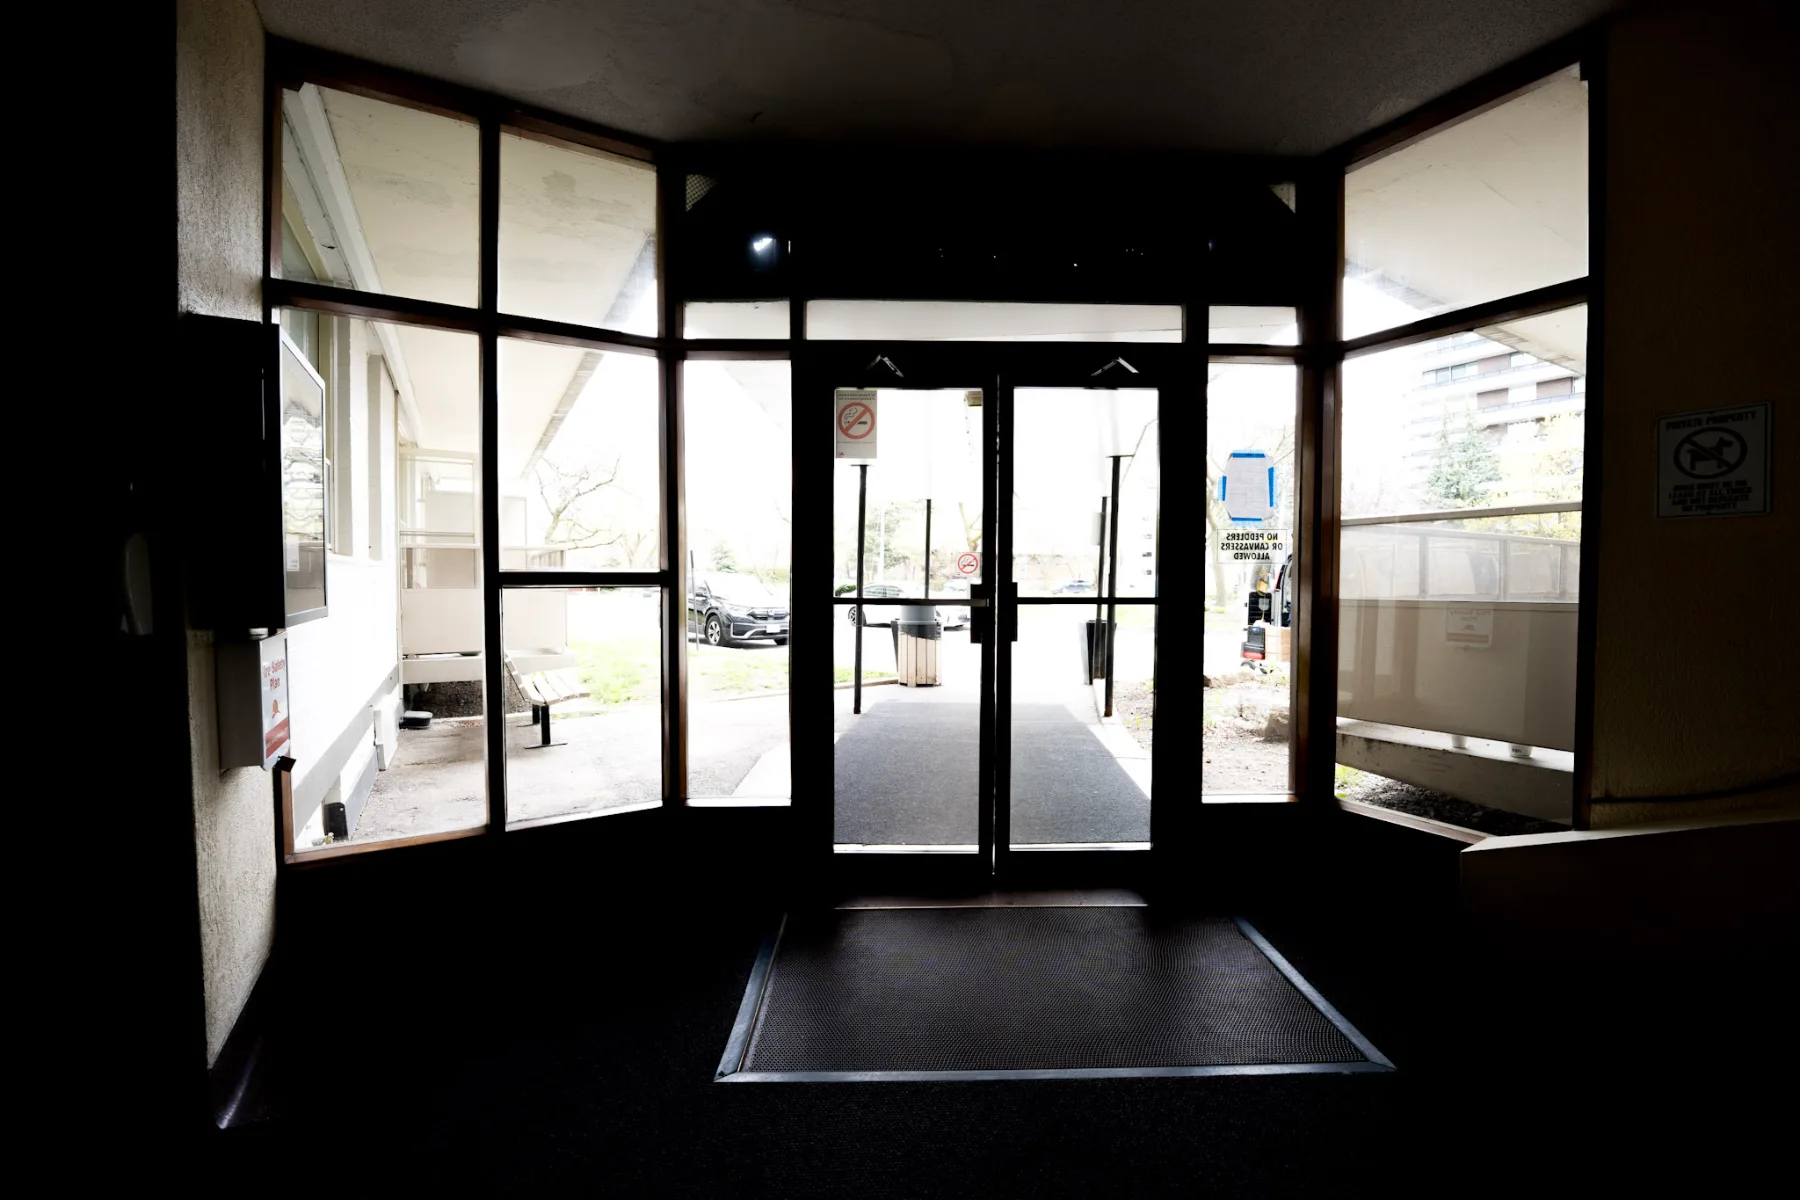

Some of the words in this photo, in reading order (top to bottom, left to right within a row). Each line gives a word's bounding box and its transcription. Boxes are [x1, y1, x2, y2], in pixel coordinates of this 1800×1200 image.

[1666, 418, 1703, 430] PRIVATE
[1706, 411, 1756, 425] PROPERTY
[270, 677, 280, 691] Plan
